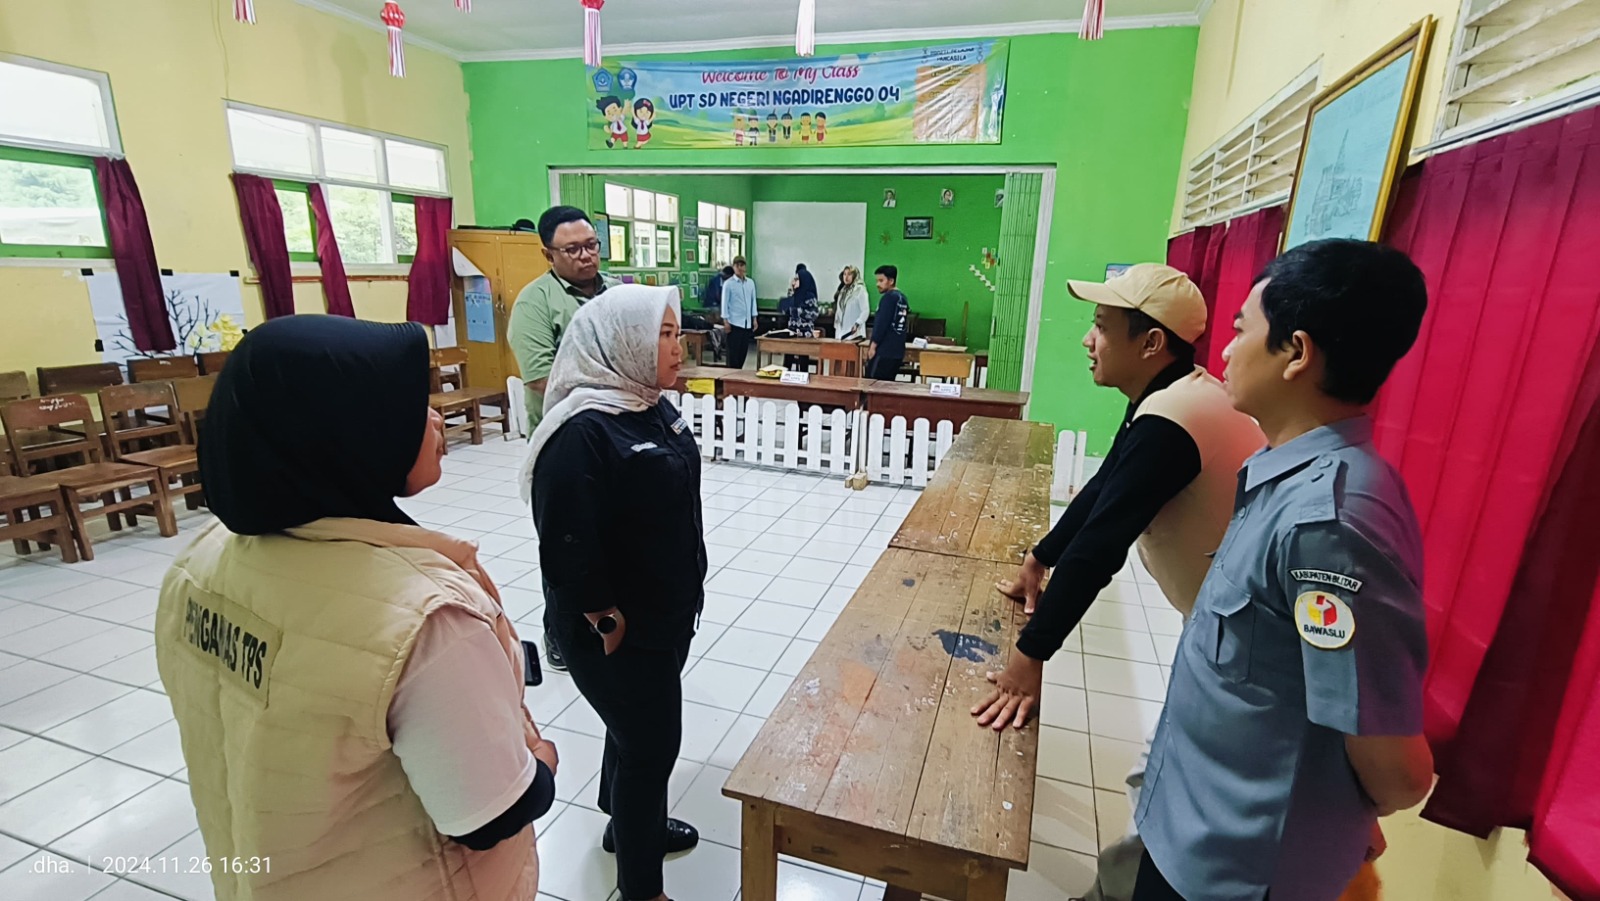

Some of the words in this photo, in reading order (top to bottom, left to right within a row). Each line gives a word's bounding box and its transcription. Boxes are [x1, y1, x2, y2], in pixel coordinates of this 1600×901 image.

[702, 69, 768, 84] Welcome
[793, 66, 817, 85] My
[669, 93, 696, 109] UPT
[698, 92, 717, 108] SD
[720, 90, 770, 107] NEGERI
[772, 87, 875, 106] NGADIRENGGO
[878, 85, 900, 102] 04
[1294, 570, 1331, 582] KABUPATEN
[1332, 574, 1359, 590] BLITAR
[1303, 625, 1346, 639] BAWASLU
[242, 631, 267, 690] TPS
